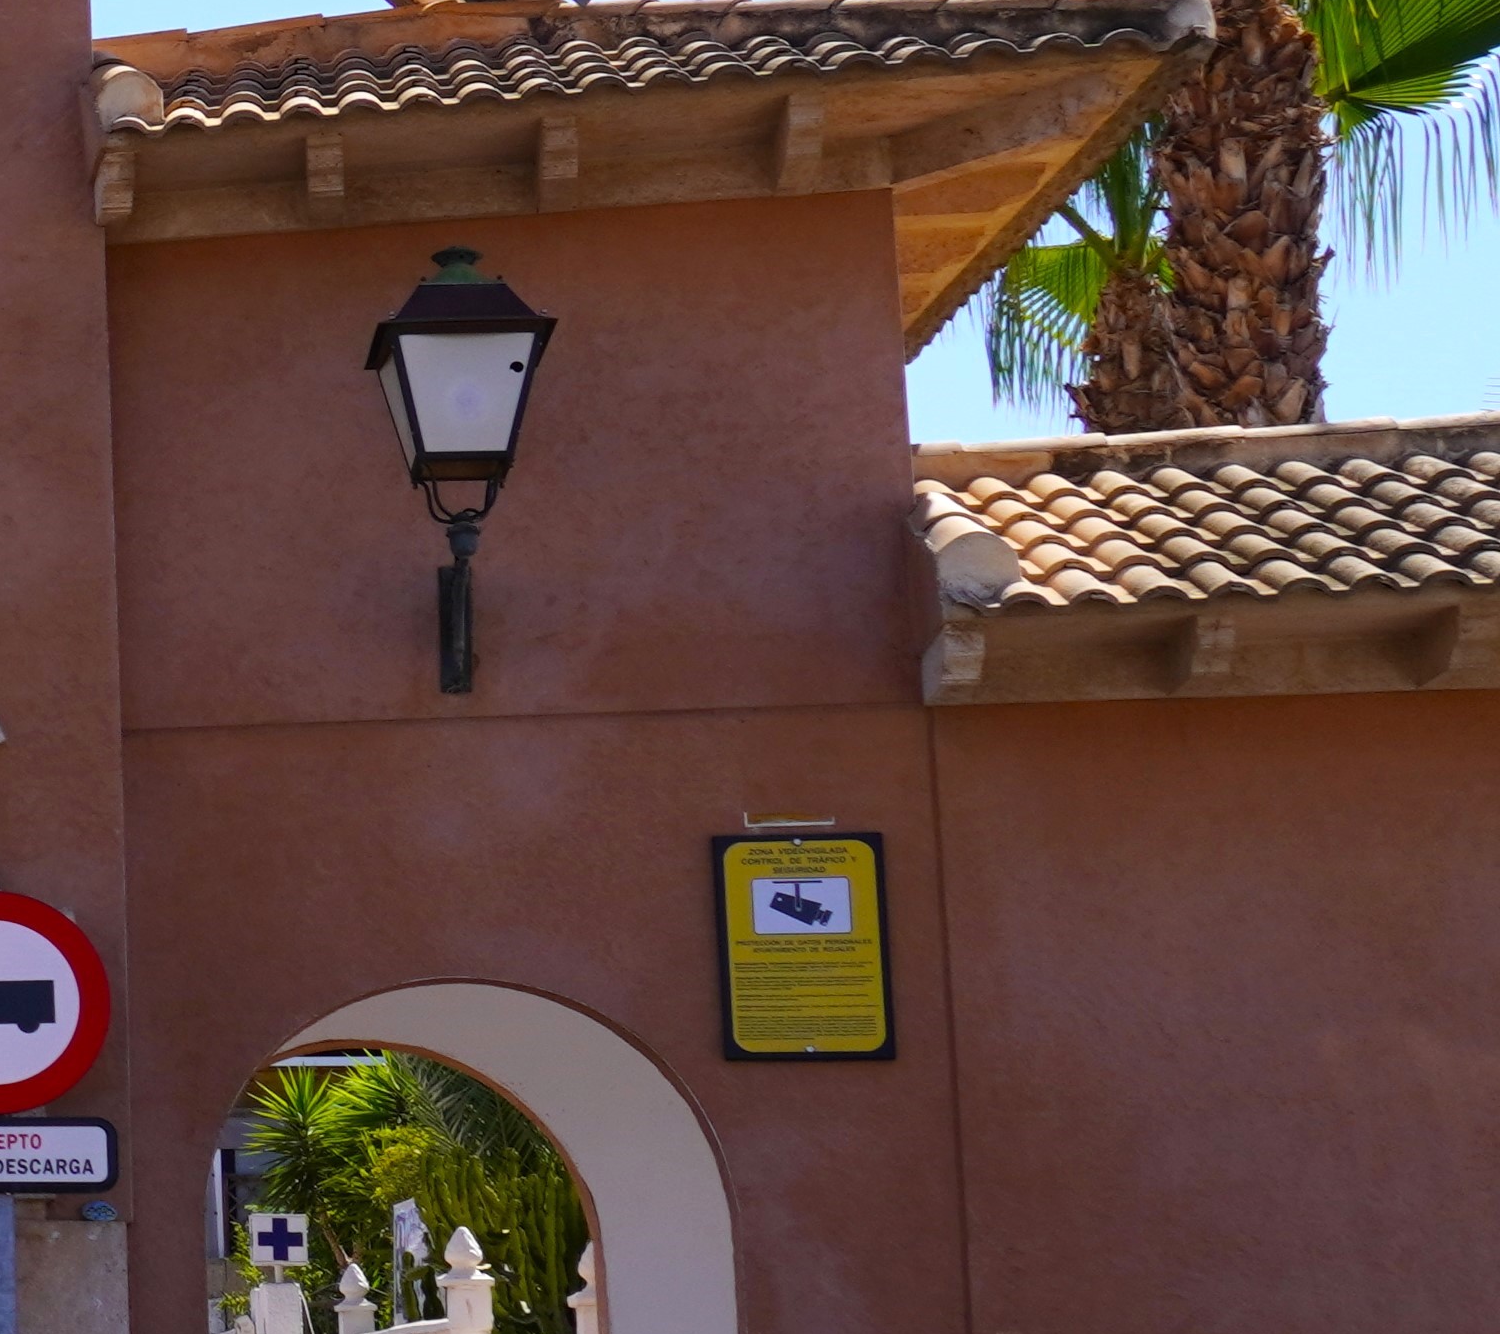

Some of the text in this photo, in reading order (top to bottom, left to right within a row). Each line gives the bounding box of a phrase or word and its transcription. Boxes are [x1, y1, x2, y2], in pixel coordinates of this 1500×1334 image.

[748, 847, 774, 856] ZONA
[741, 857, 783, 866] CONTROL
[790, 857, 801, 865] DE
[772, 866, 826, 874] SEGURIDAD
